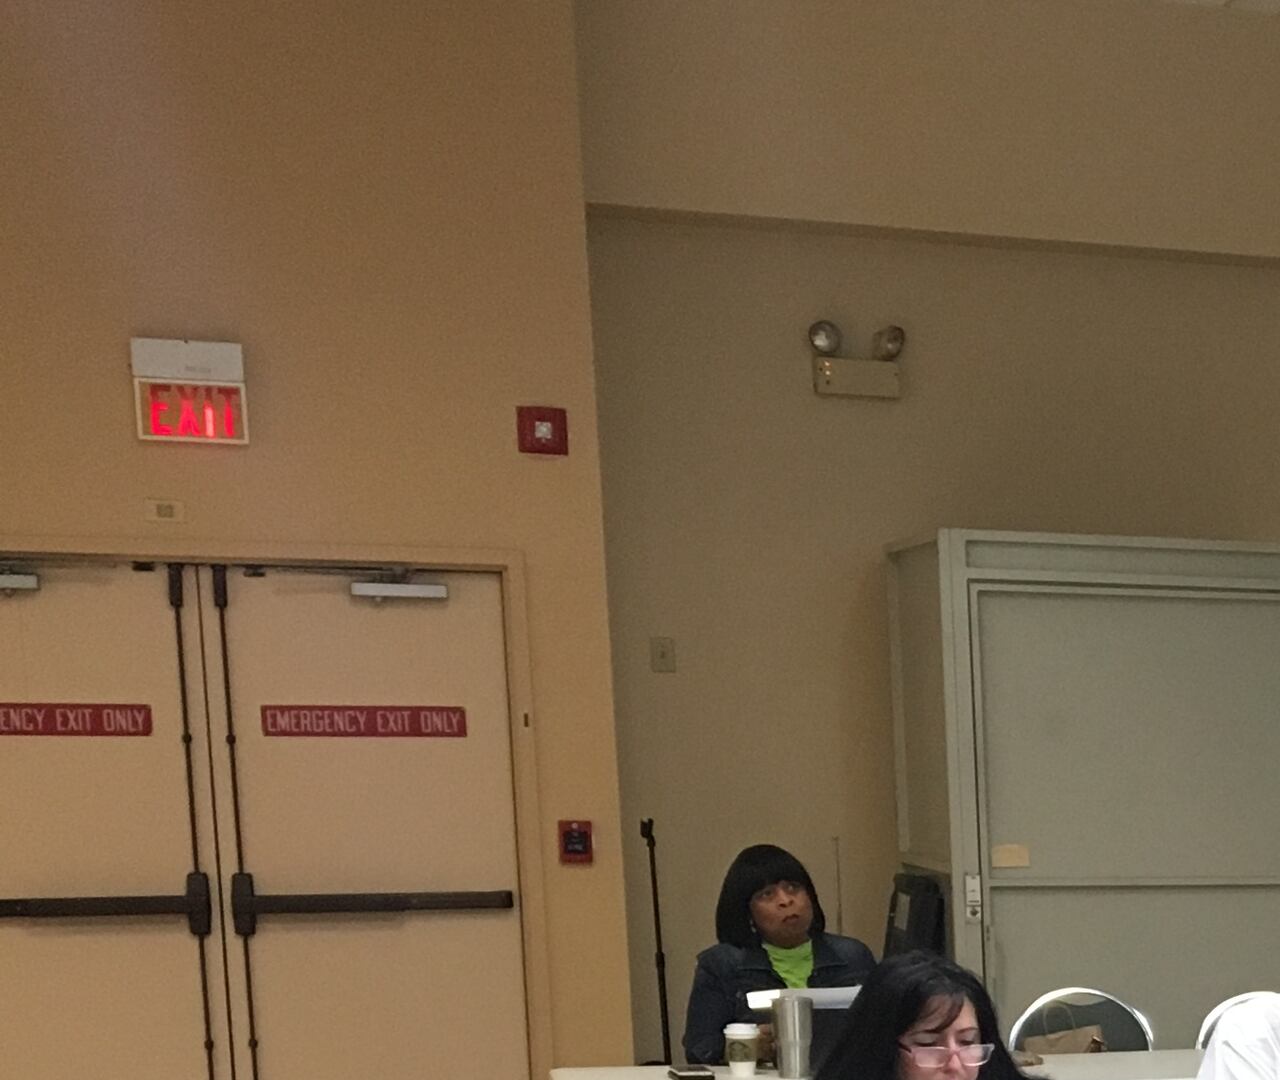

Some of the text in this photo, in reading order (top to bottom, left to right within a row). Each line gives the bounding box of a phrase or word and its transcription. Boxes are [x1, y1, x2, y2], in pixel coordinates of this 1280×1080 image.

[148, 384, 241, 438] EXIT
[55, 708, 93, 731] EXIT
[102, 709, 146, 732] ONLY
[266, 709, 461, 733] EMERGENCY EXIT ONLY
